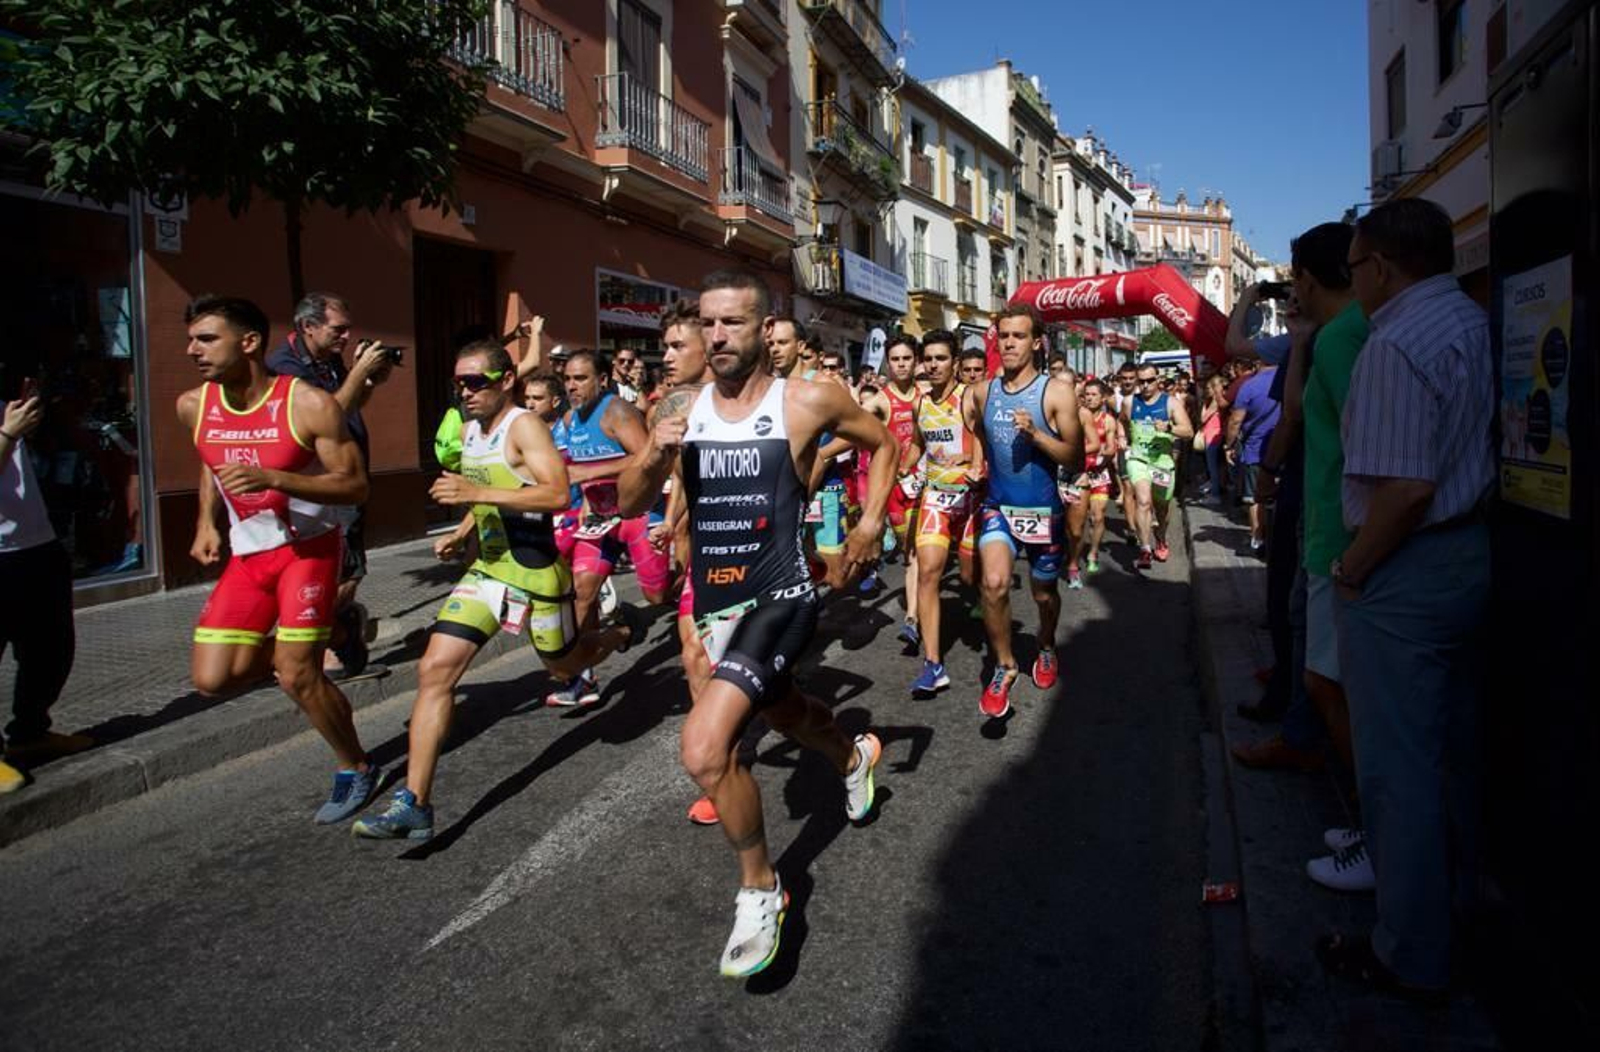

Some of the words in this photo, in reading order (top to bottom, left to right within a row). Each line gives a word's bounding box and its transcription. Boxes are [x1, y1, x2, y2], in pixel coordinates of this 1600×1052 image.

[224, 449, 262, 468] MESA
[699, 448, 760, 479] MONTORO
[936, 493, 957, 506] 47
[698, 520, 752, 532] LASERGRAN
[1014, 519, 1039, 535] 52
[706, 565, 748, 584] HSN
